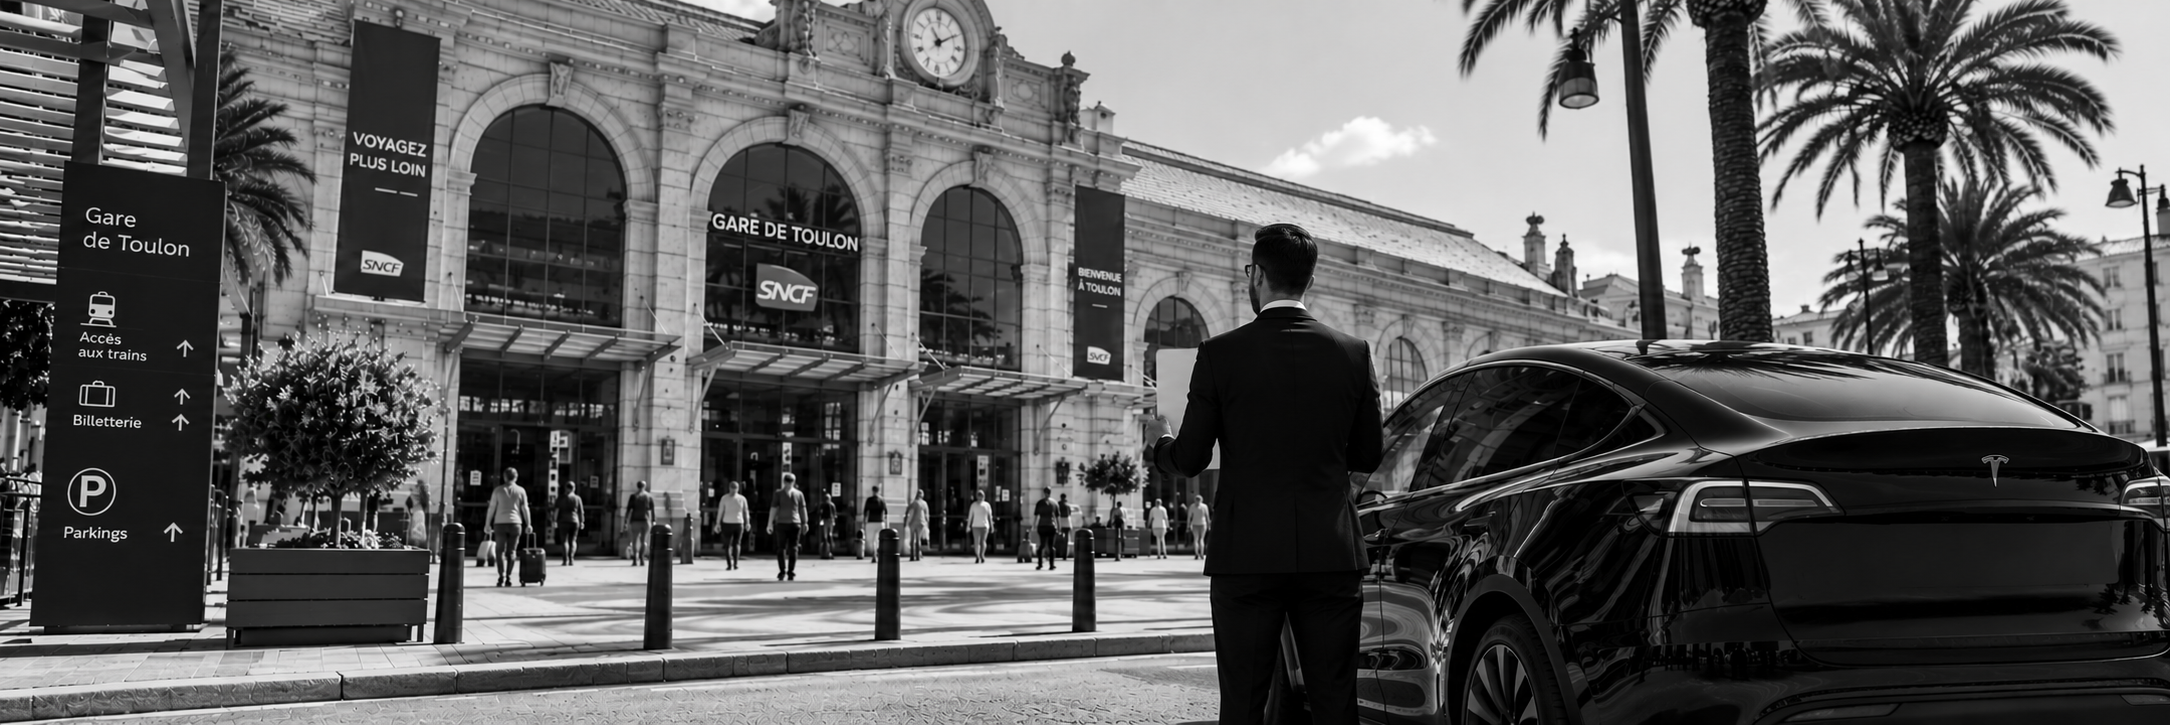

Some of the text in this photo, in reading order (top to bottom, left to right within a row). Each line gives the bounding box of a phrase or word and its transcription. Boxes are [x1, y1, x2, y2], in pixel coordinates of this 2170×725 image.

[353, 131, 427, 158] VOYAGEZ
[350, 152, 426, 178] PLUS LOIN
[85, 207, 137, 228] Gare
[712, 213, 859, 252] GARE DE TOULON
[83, 231, 190, 257] de Toulon
[362, 259, 402, 274] SNCF
[1078, 266, 1122, 283] BIENVENUE
[757, 280, 817, 304] SNCF
[1085, 282, 1121, 297] TOULON
[78, 348, 147, 362] aux trains
[73, 414, 142, 429] Billetterie
[79, 475, 107, 508] P
[63, 526, 128, 542] Parkings
